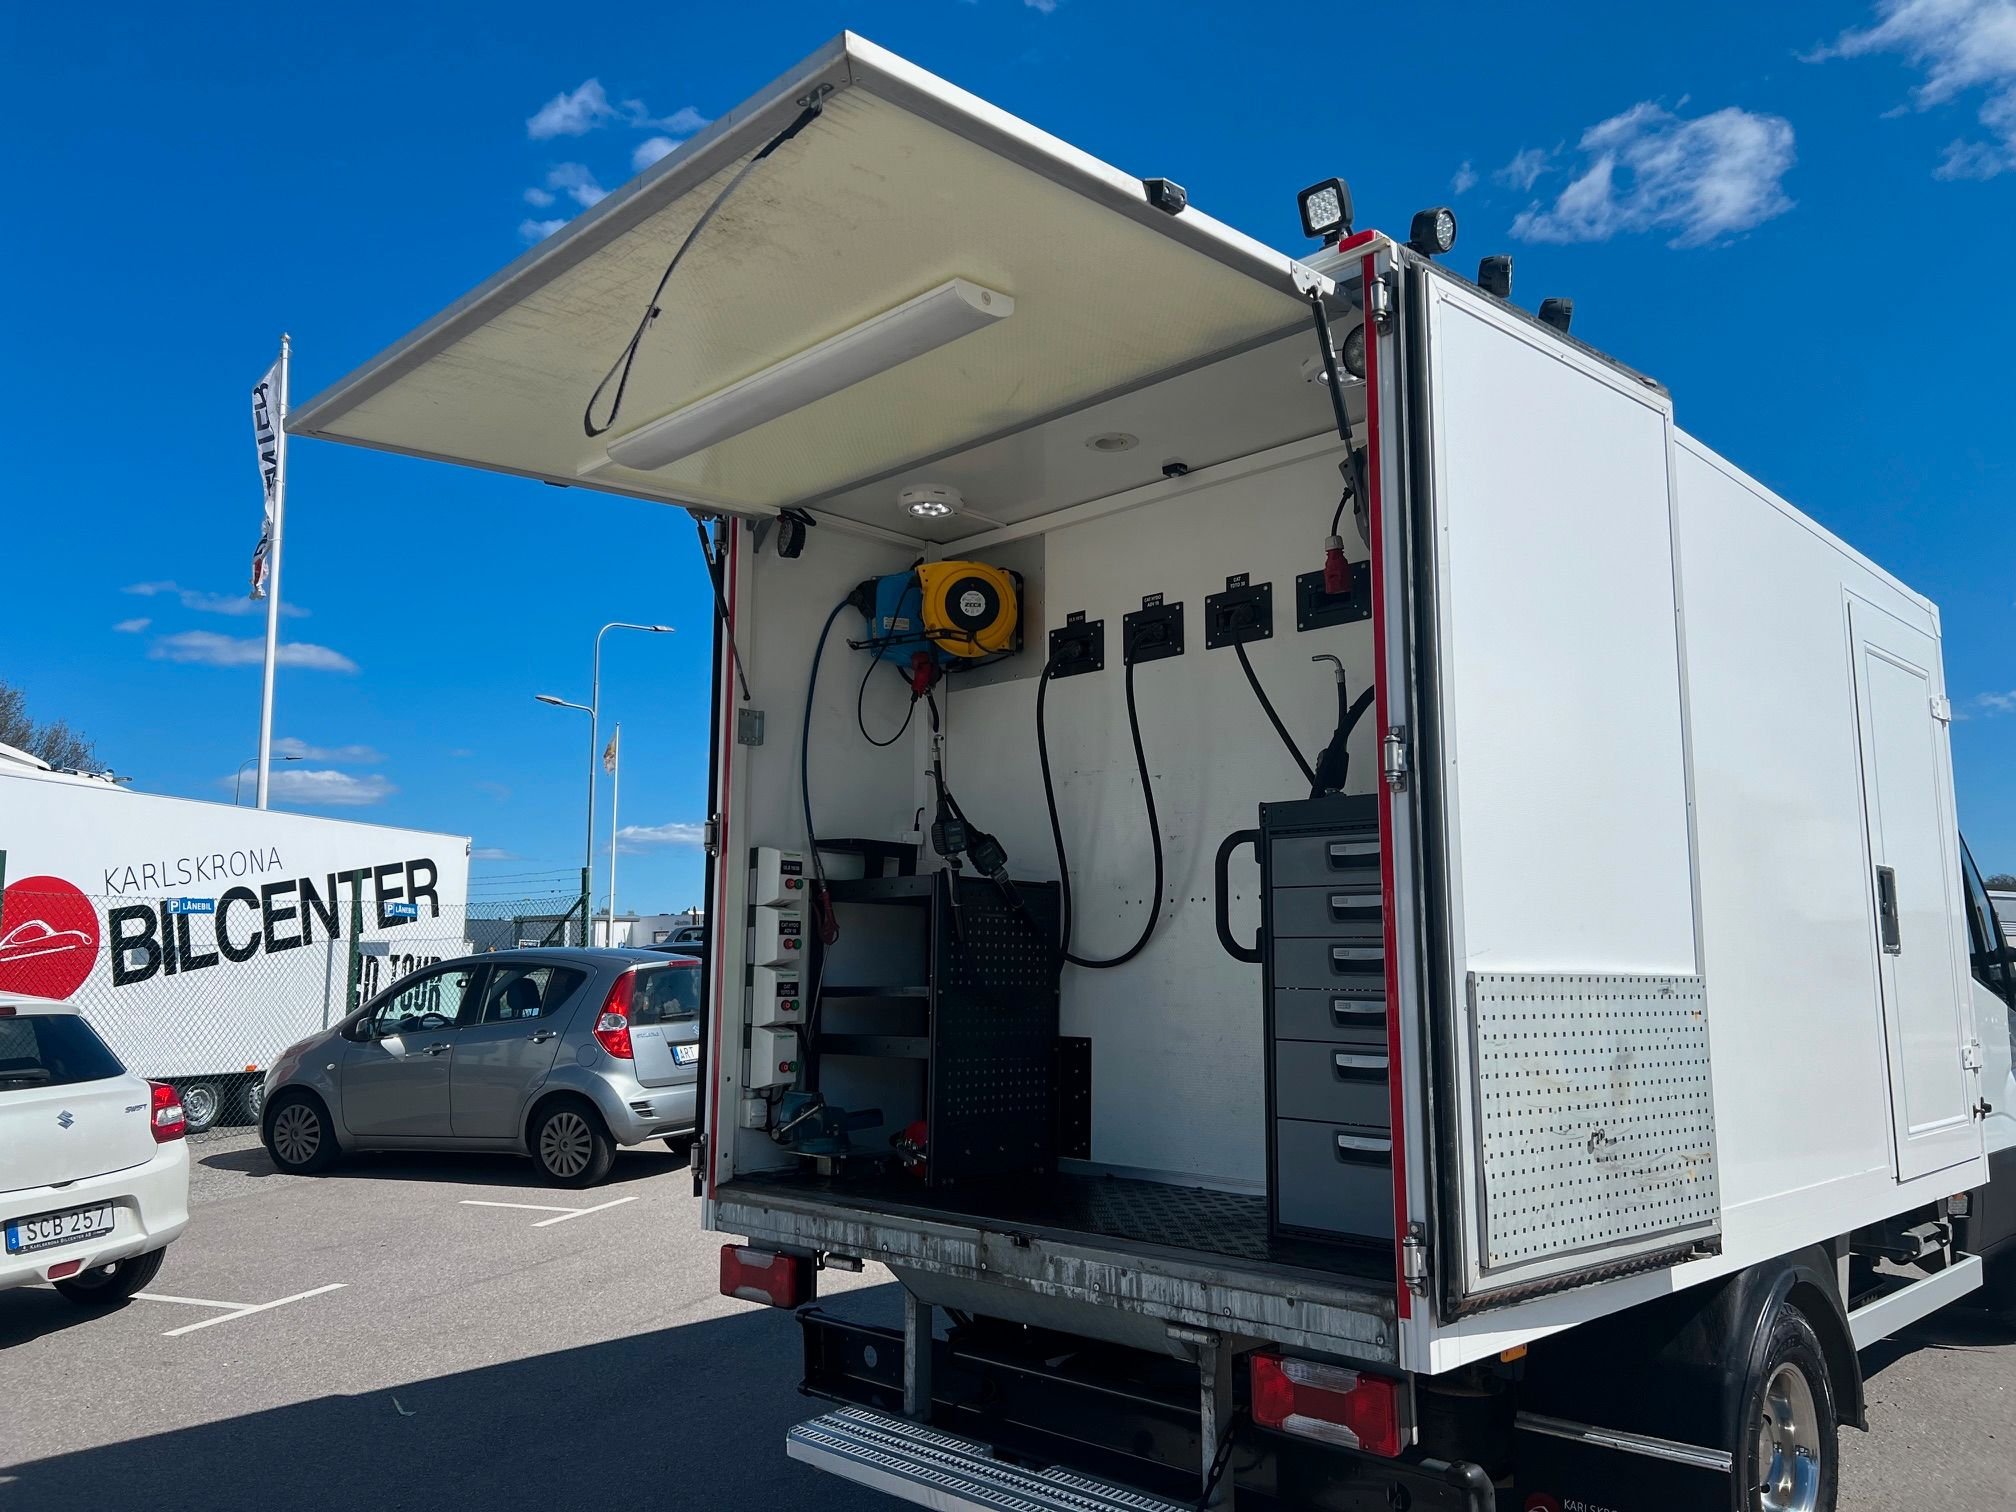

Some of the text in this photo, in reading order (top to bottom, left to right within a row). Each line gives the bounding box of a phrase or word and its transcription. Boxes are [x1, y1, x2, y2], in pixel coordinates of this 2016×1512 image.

[104, 846, 283, 896] KARLSKRONA
[108, 857, 440, 988] BILCENTER
[182, 900, 212, 911] LÅNEBIL
[26, 1206, 105, 1242] SCB 257
[1563, 1498, 1618, 1512] KARLSK
